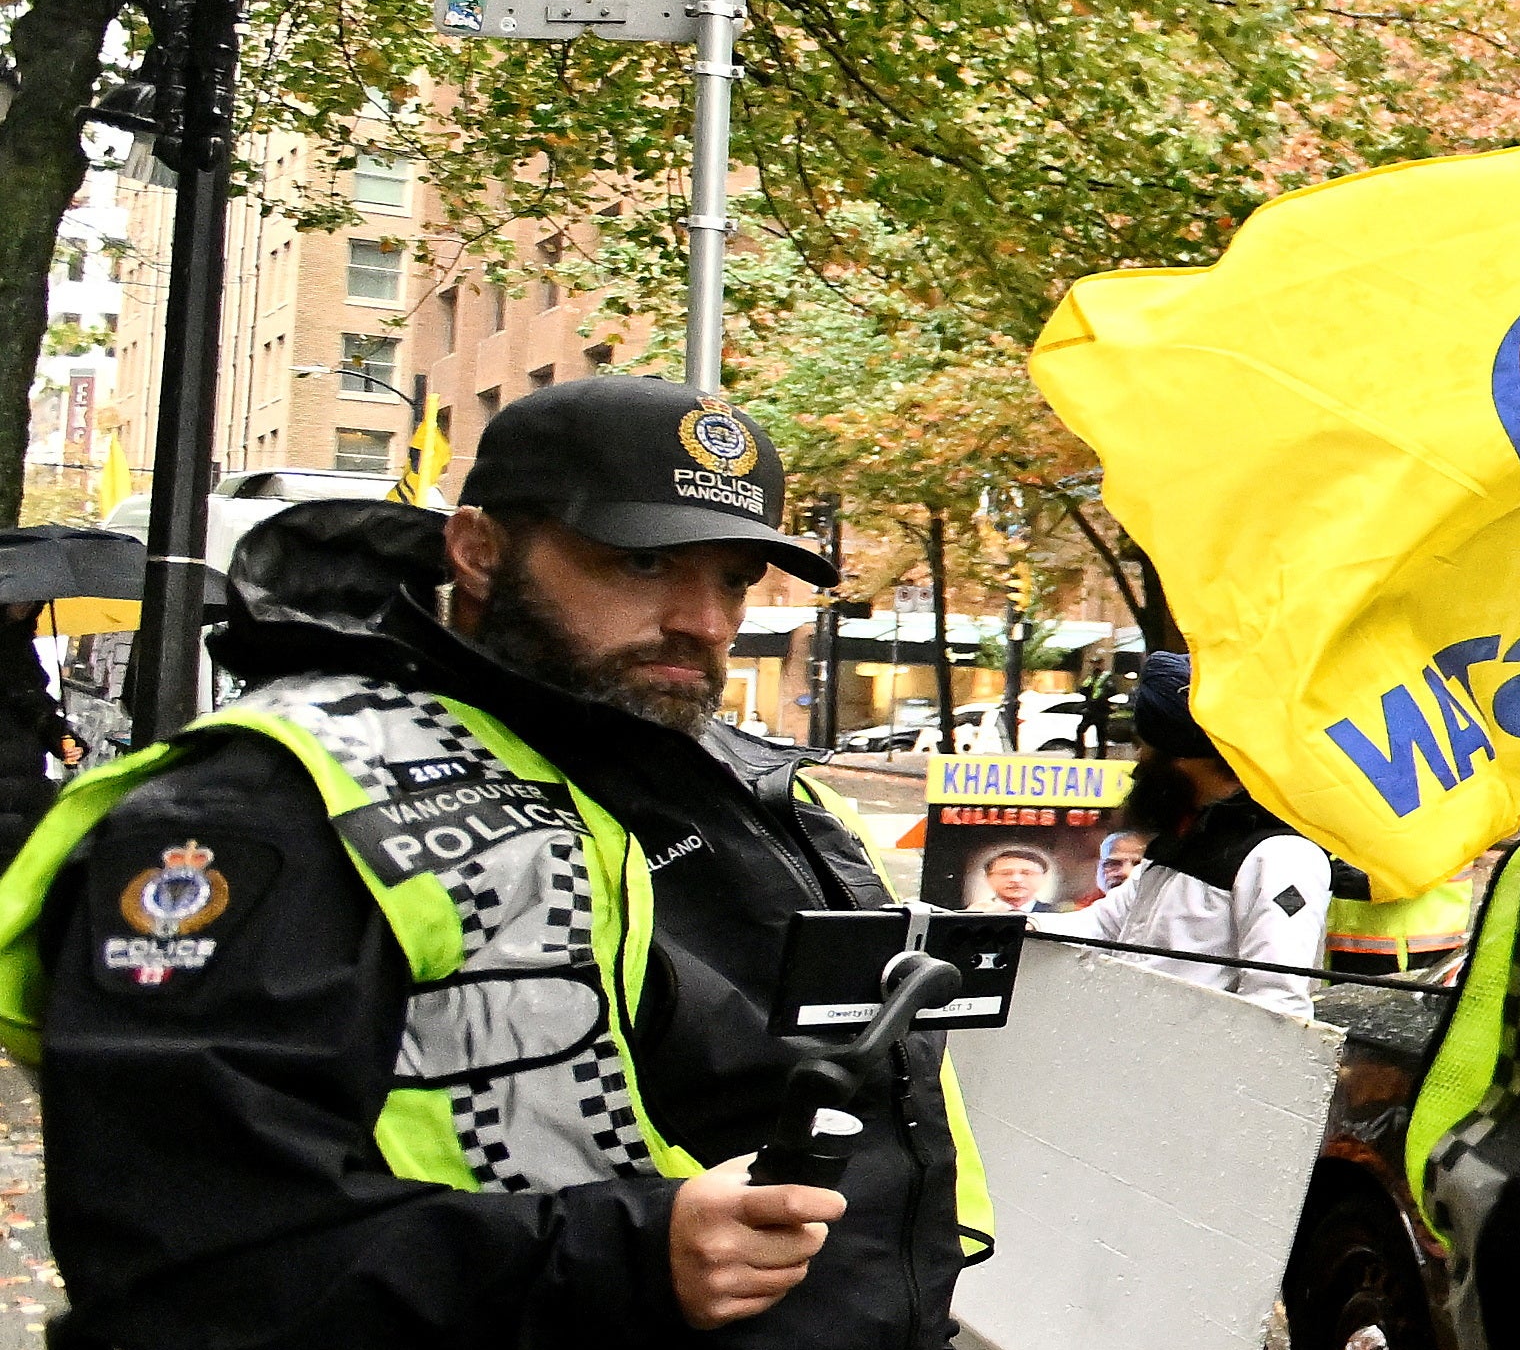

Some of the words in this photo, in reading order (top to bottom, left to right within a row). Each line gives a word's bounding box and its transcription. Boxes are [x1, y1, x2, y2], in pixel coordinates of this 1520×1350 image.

[673, 468, 764, 504] POLICE
[675, 483, 764, 516] VANCOUVER
[943, 762, 1103, 798] KHALISTAN
[378, 783, 549, 825] VANCOUVER
[381, 803, 591, 872] POLICE
[647, 835, 703, 872] LLAND
